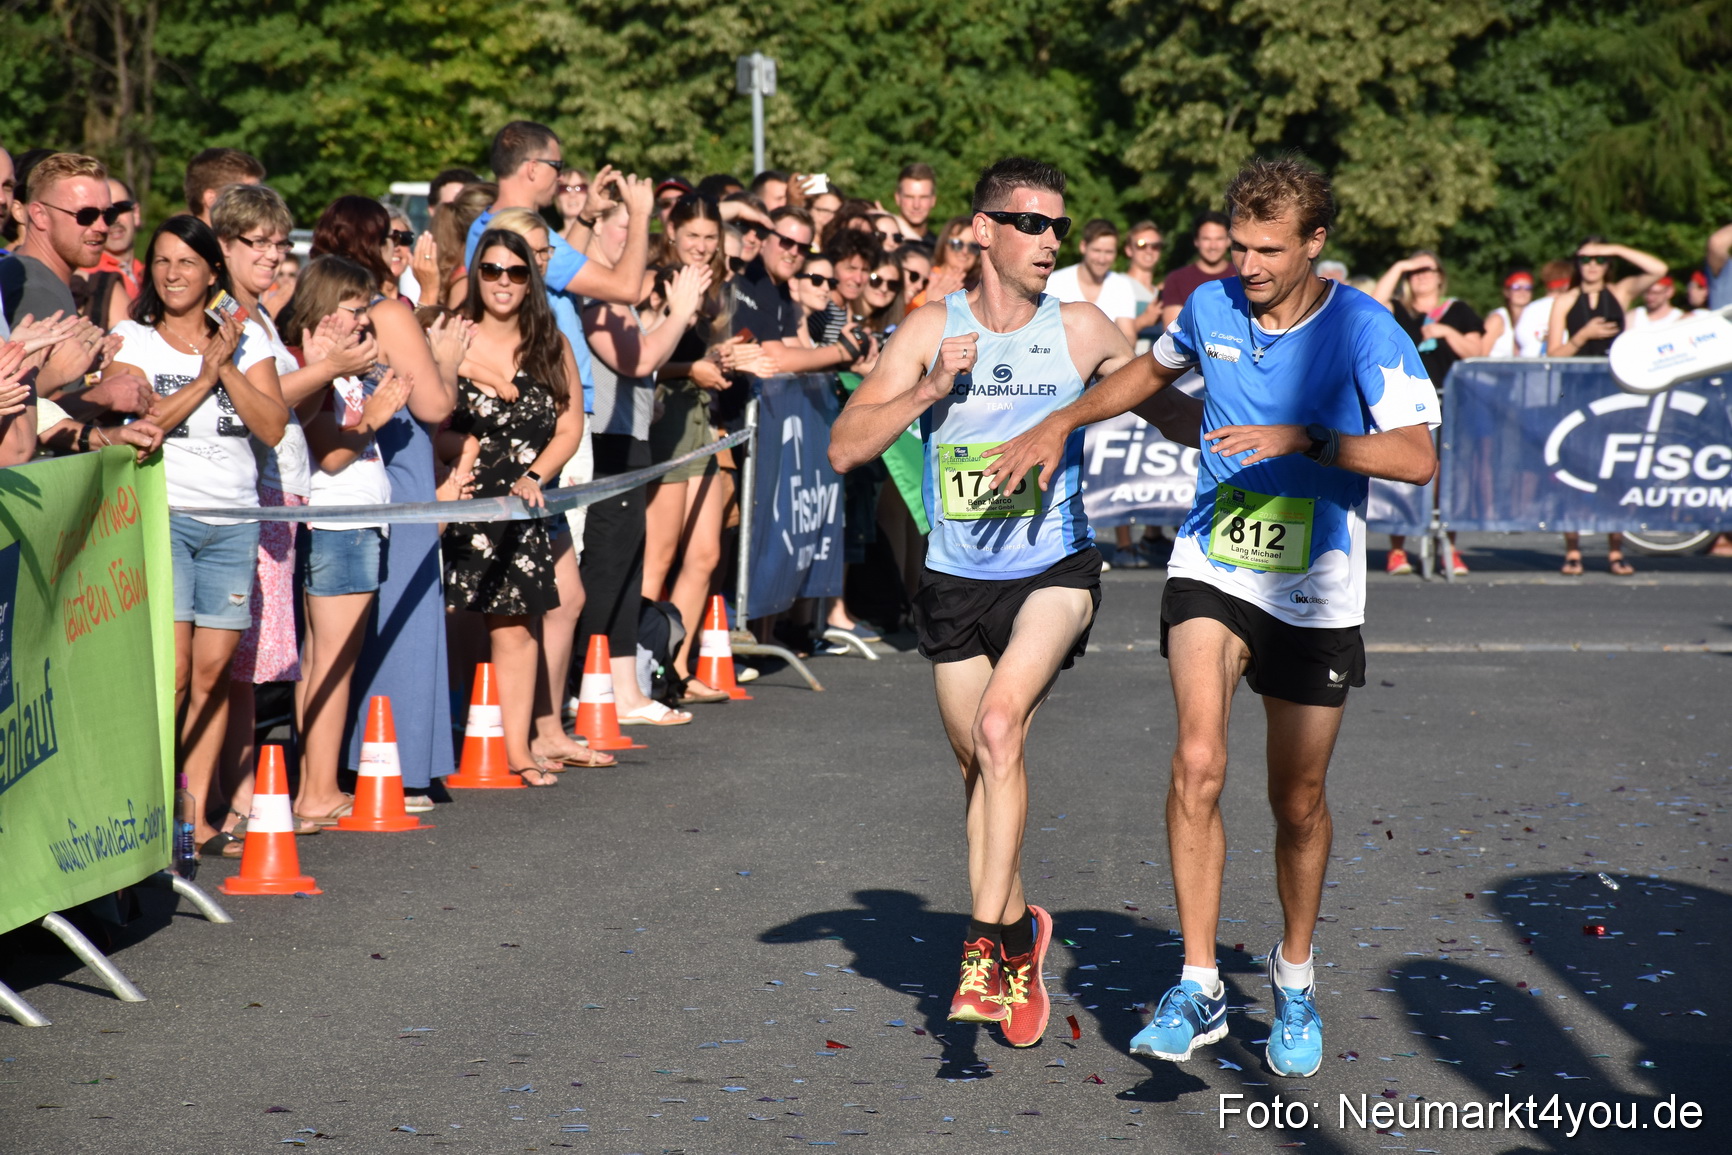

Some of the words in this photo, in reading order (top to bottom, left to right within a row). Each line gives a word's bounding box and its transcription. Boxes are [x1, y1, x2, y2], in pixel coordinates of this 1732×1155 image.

[949, 383, 1057, 396] SCHABMÜLLER
[987, 402, 1014, 411] TEAM
[1230, 516, 1287, 551] 812
[1231, 544, 1249, 556] Lang
[1251, 548, 1282, 559] Michael
[64, 571, 116, 645] laufen
